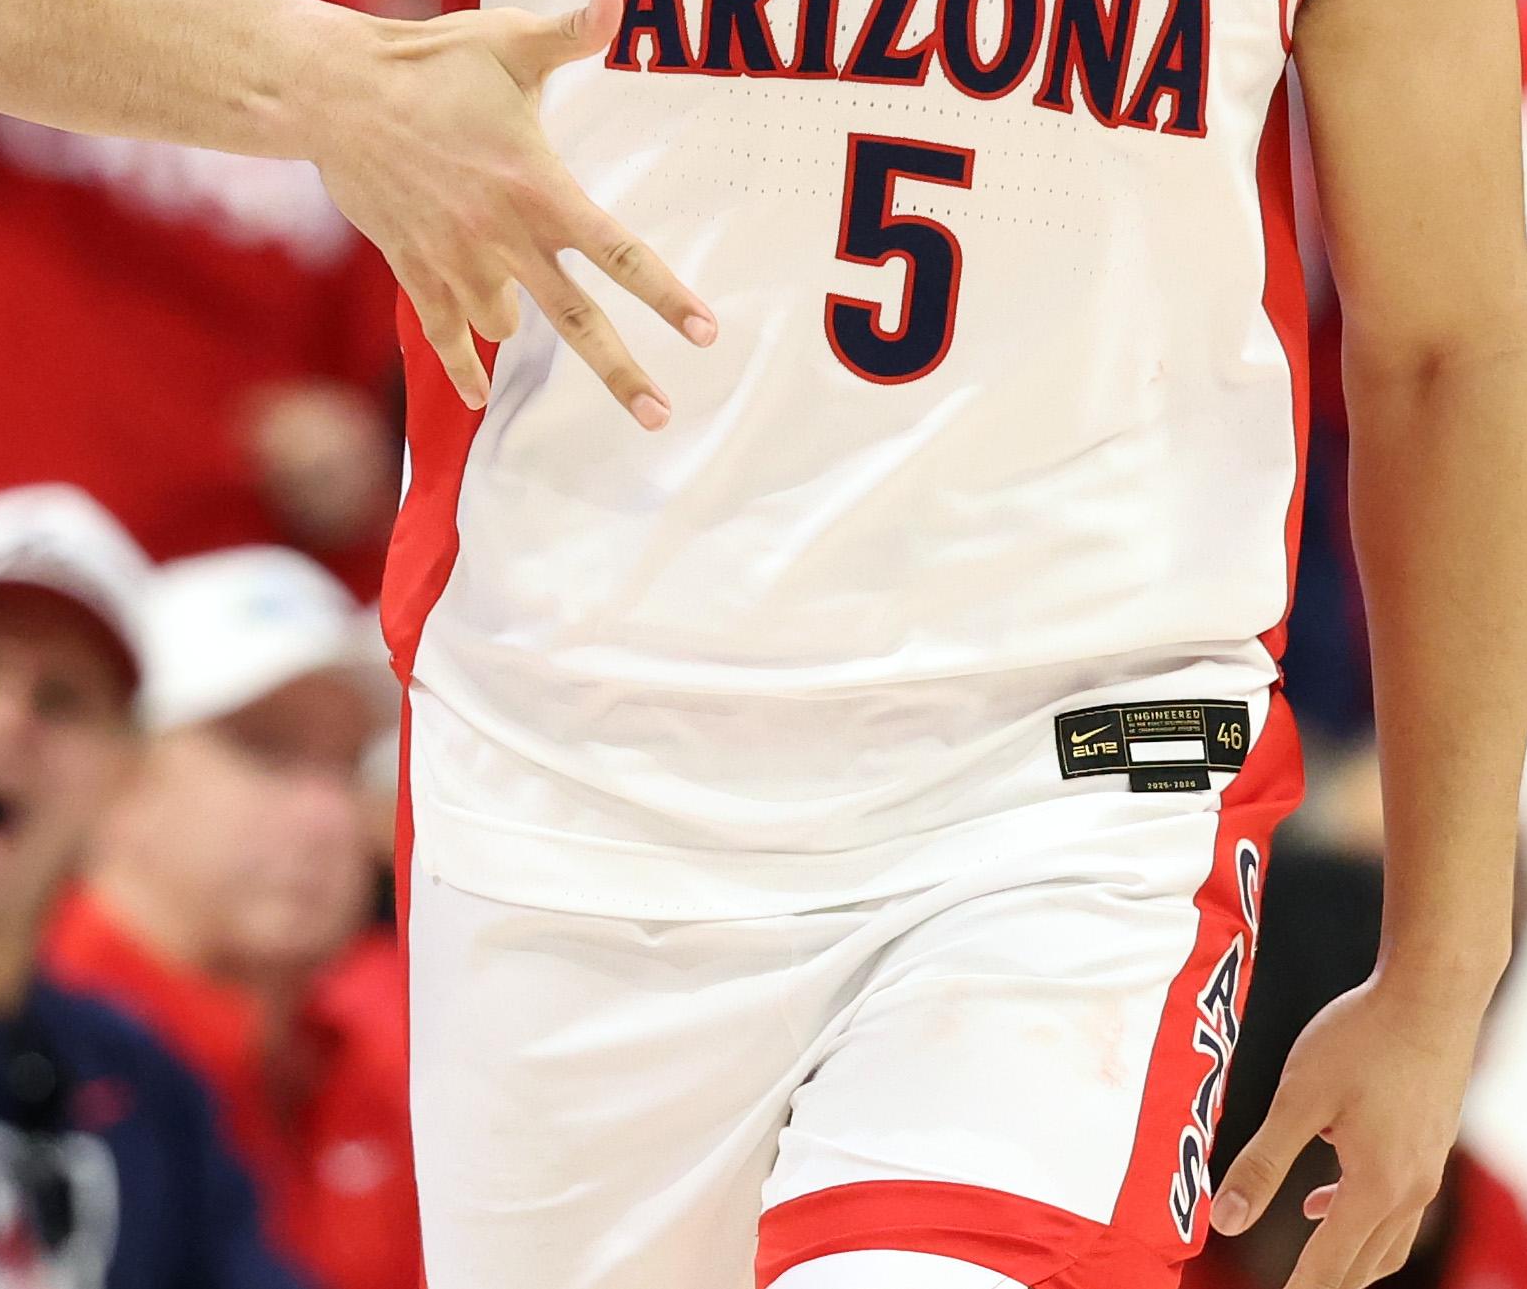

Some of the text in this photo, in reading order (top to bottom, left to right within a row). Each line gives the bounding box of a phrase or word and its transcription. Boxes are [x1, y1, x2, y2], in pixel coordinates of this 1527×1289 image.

[824, 132, 976, 386] 5
[1126, 709, 1201, 722] ENGINEERED
[1216, 722, 1243, 750] 46
[1073, 741, 1119, 758] ELITE
